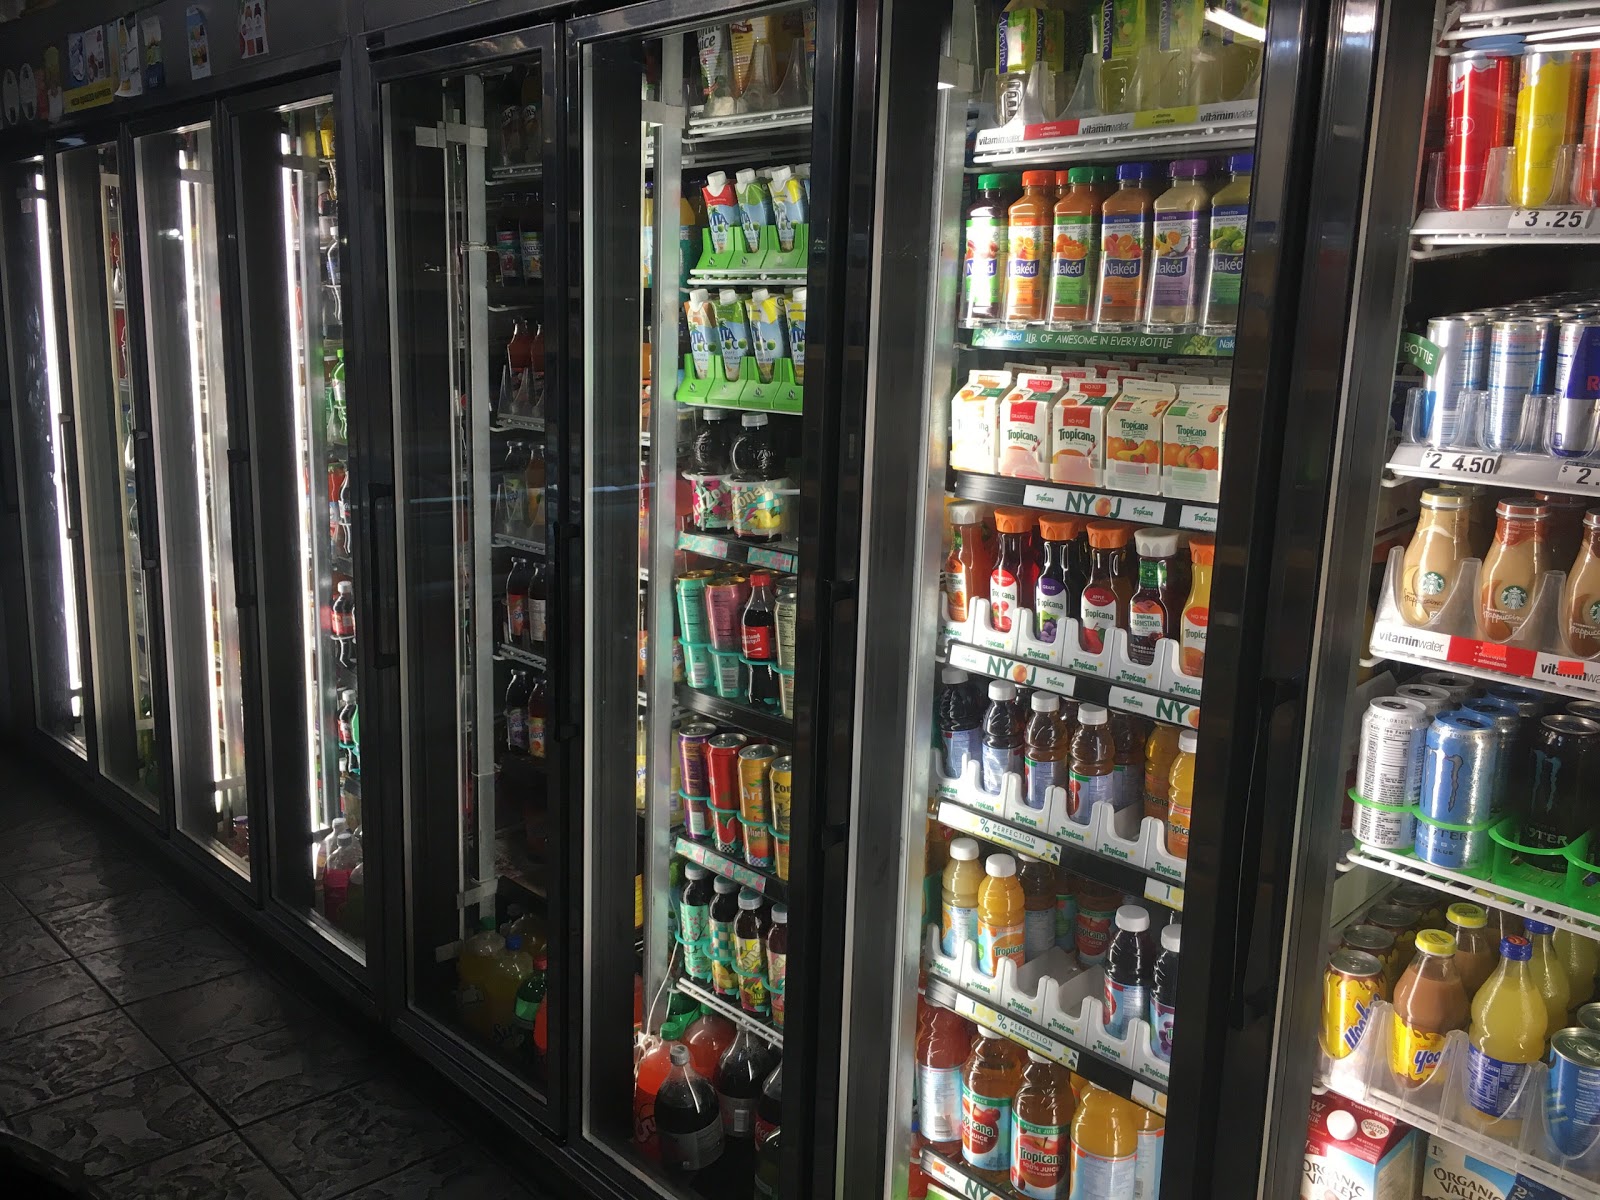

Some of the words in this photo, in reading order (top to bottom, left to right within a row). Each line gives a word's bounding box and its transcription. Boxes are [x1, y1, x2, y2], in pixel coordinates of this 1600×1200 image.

[1104, 0, 1112, 52] Aloevine
[1160, 2, 1168, 42] oevine
[1000, 16, 1008, 66] Aloevine
[1200, 109, 1254, 122] vitaminwater
[1082, 122, 1130, 134] vitaminwater
[1105, 262, 1137, 275] Naked
[1156, 261, 1183, 274] Naked
[1040, 333, 1053, 343] OF
[1055, 334, 1098, 345] AWESOME
[1100, 336, 1109, 345] IN
[1110, 336, 1137, 347] EVERY
[1140, 336, 1174, 349] BOTTLE
[1218, 338, 1235, 349] Nak
[1404, 342, 1434, 365] BOTTLE
[1120, 419, 1149, 431] Tropicana
[1176, 425, 1207, 437] Tropicana
[1008, 429, 1038, 442] Tropicana
[1058, 428, 1096, 443] Tropicana
[1429, 453, 1441, 469] 2
[1452, 455, 1495, 474] 4.50
[1035, 493, 1055, 503] Tropicana
[1132, 506, 1154, 517] Tropicana
[1194, 512, 1216, 523] Tropicana
[992, 588, 1015, 601] Trocana
[1037, 597, 1064, 610] Topicana
[1085, 608, 1114, 621] Tropicana
[1136, 613, 1154, 621] Tropicana
[985, 637, 1005, 650] ropicana
[1027, 648, 1050, 660] Tropicana
[1073, 658, 1098, 672] Tropicana
[1046, 677, 1065, 688] Tropicana
[1121, 670, 1146, 684] Tropicana
[1174, 682, 1200, 696] Tropicana
[1123, 696, 1143, 707] Tropicana
[975, 799, 994, 813] ropicana
[1015, 812, 1037, 827] Tropicana
[992, 823, 1036, 845] PERFECTION
[1061, 826, 1085, 842] Tropicana
[1103, 843, 1128, 859] Tropicana
[1155, 862, 1182, 878] Tropicana
[1011, 997, 1033, 1016] Tropicana
[1052, 1018, 1075, 1036] Tropicana
[1010, 1021, 1054, 1048] PERFECTION
[1096, 1040, 1121, 1058] Tropicana
[1144, 1063, 1169, 1080] Tropicana
[1024, 1124, 1041, 1134] APPLE
[1363, 1120, 1387, 1134] ORGANIC
[1364, 1124, 1385, 1136] VALLEY
[1023, 1161, 1039, 1172] 100%
